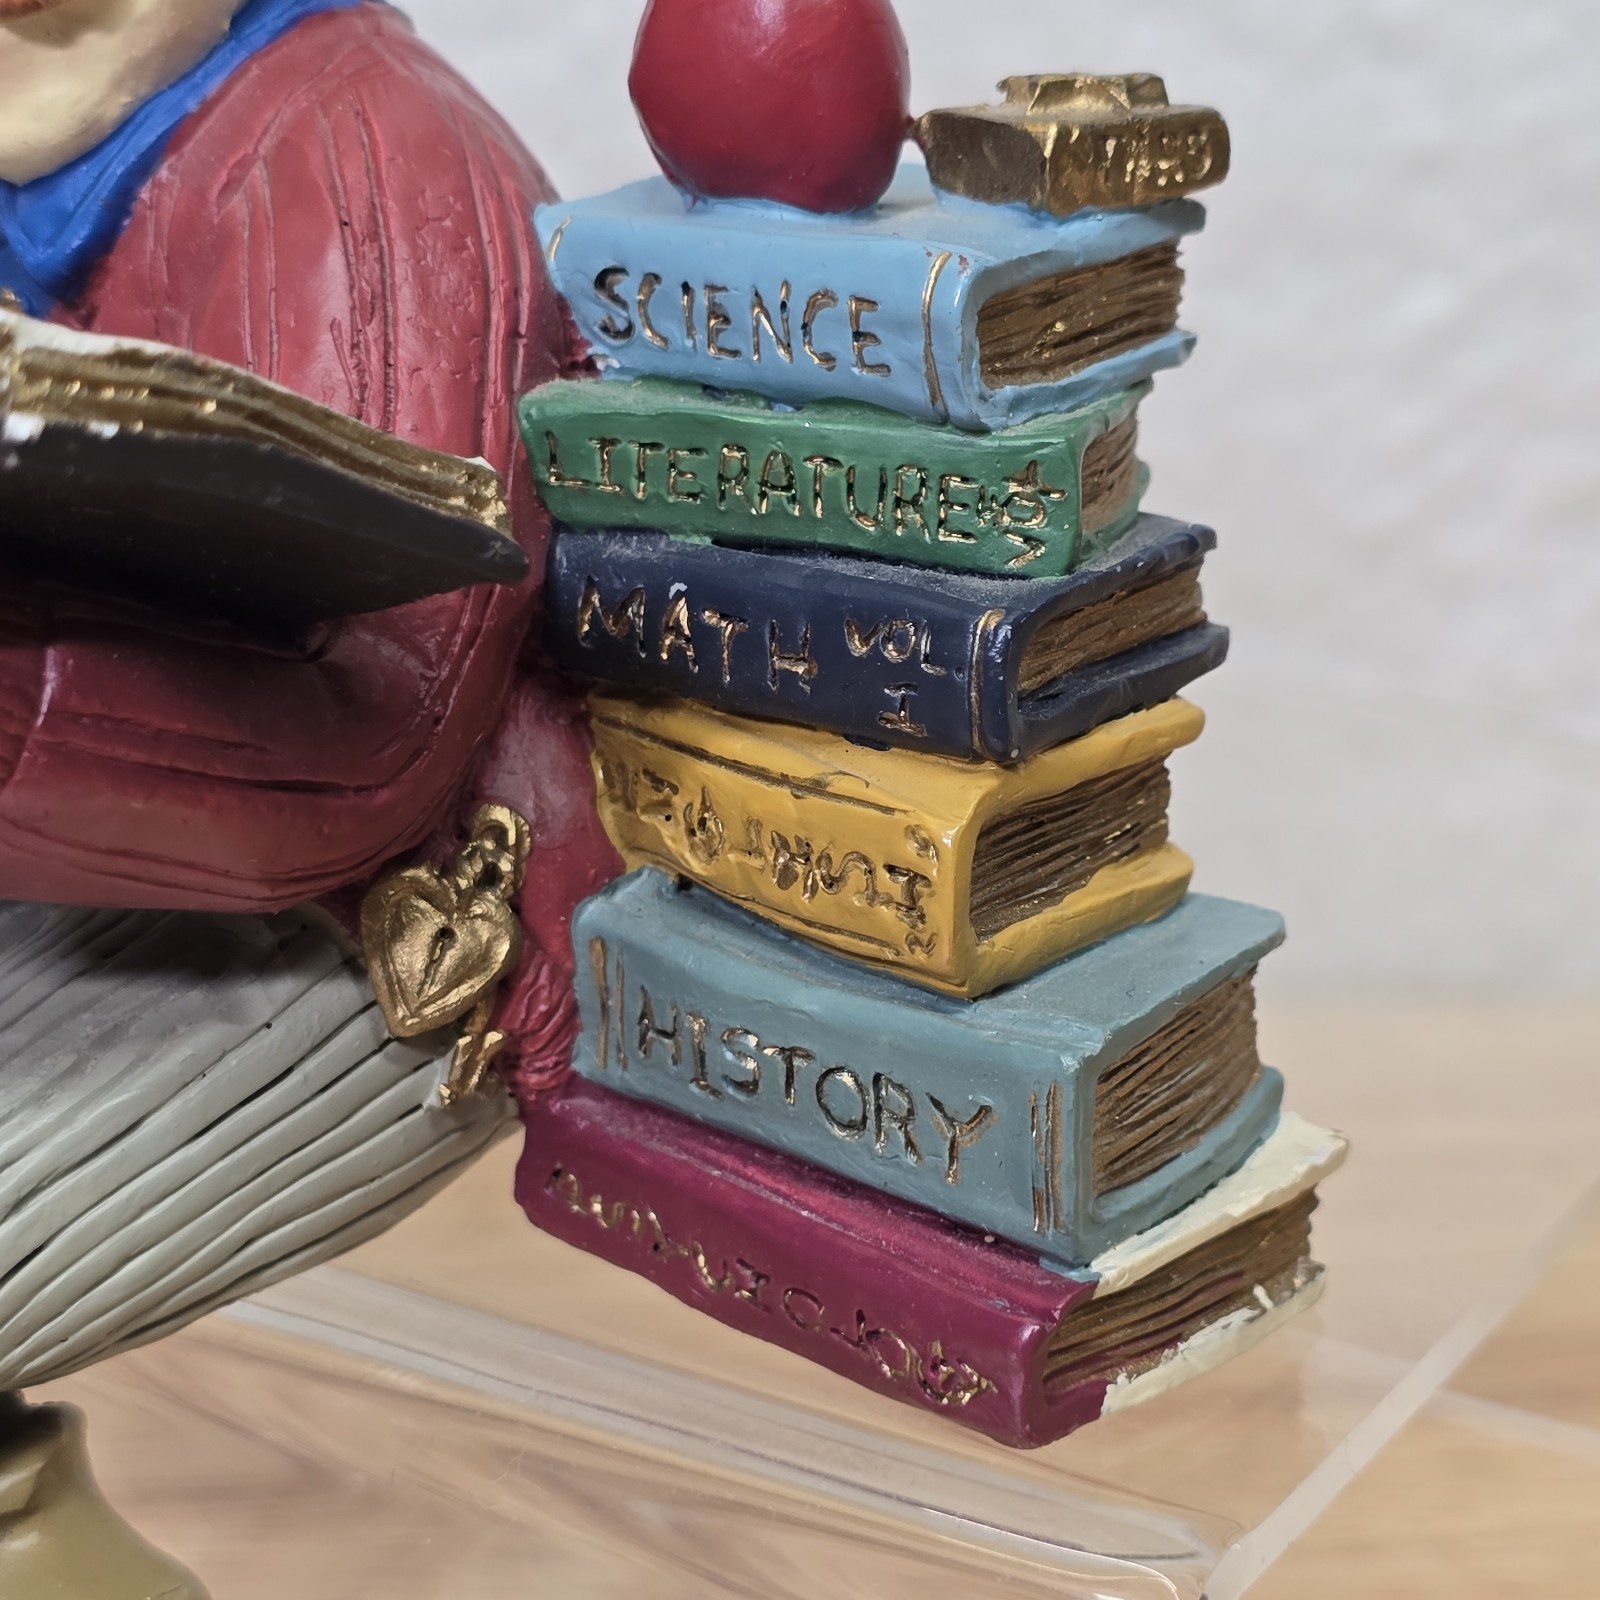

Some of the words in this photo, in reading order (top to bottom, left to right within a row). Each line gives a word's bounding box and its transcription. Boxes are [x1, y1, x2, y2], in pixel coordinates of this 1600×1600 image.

[593, 265, 892, 378] SCIENCE
[544, 430, 979, 545] LITERATURE
[576, 574, 819, 696] MATH
[637, 984, 999, 1186] HISTORY
